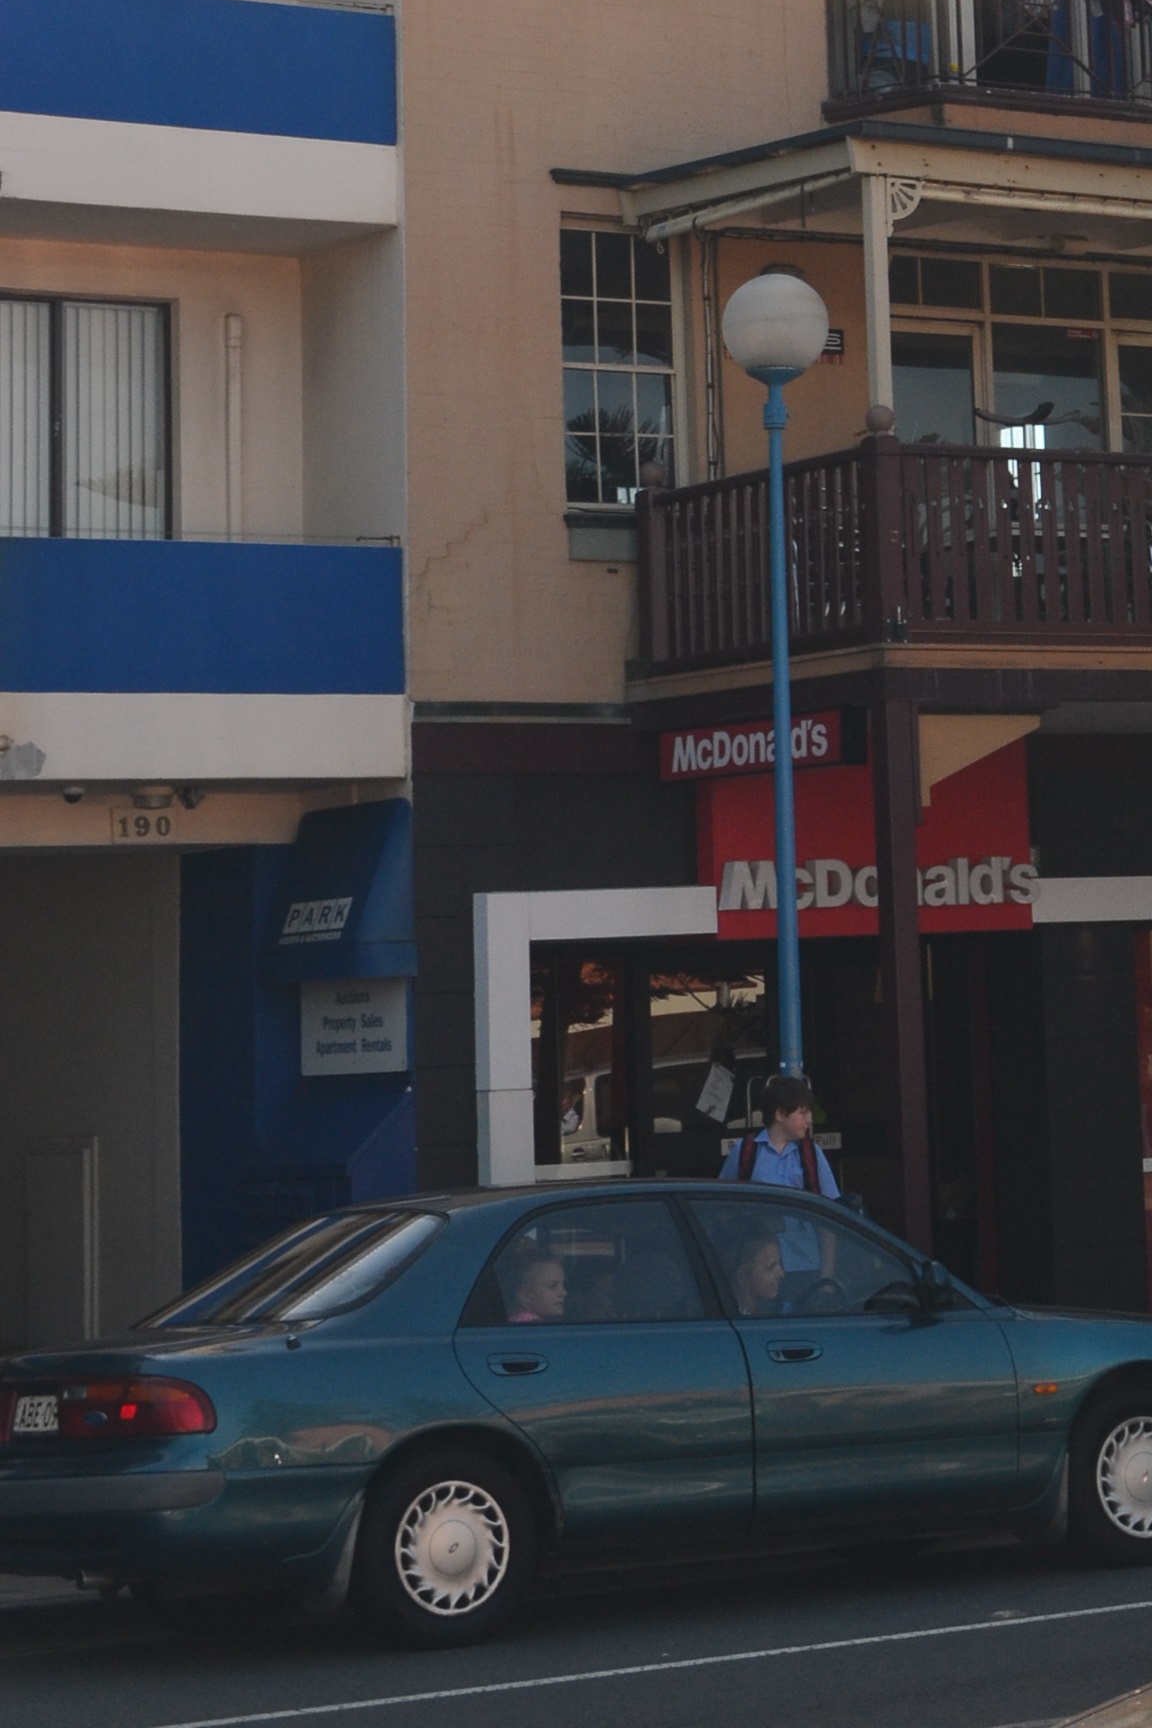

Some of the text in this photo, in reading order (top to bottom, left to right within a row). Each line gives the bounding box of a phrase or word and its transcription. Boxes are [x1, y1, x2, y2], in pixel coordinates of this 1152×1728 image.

[671, 718, 829, 774] McDonad's
[118, 815, 171, 838] 190
[286, 903, 347, 928] PARK
[322, 1014, 383, 1033] Property Sales
[315, 1038, 393, 1057] Apartment Rentals
